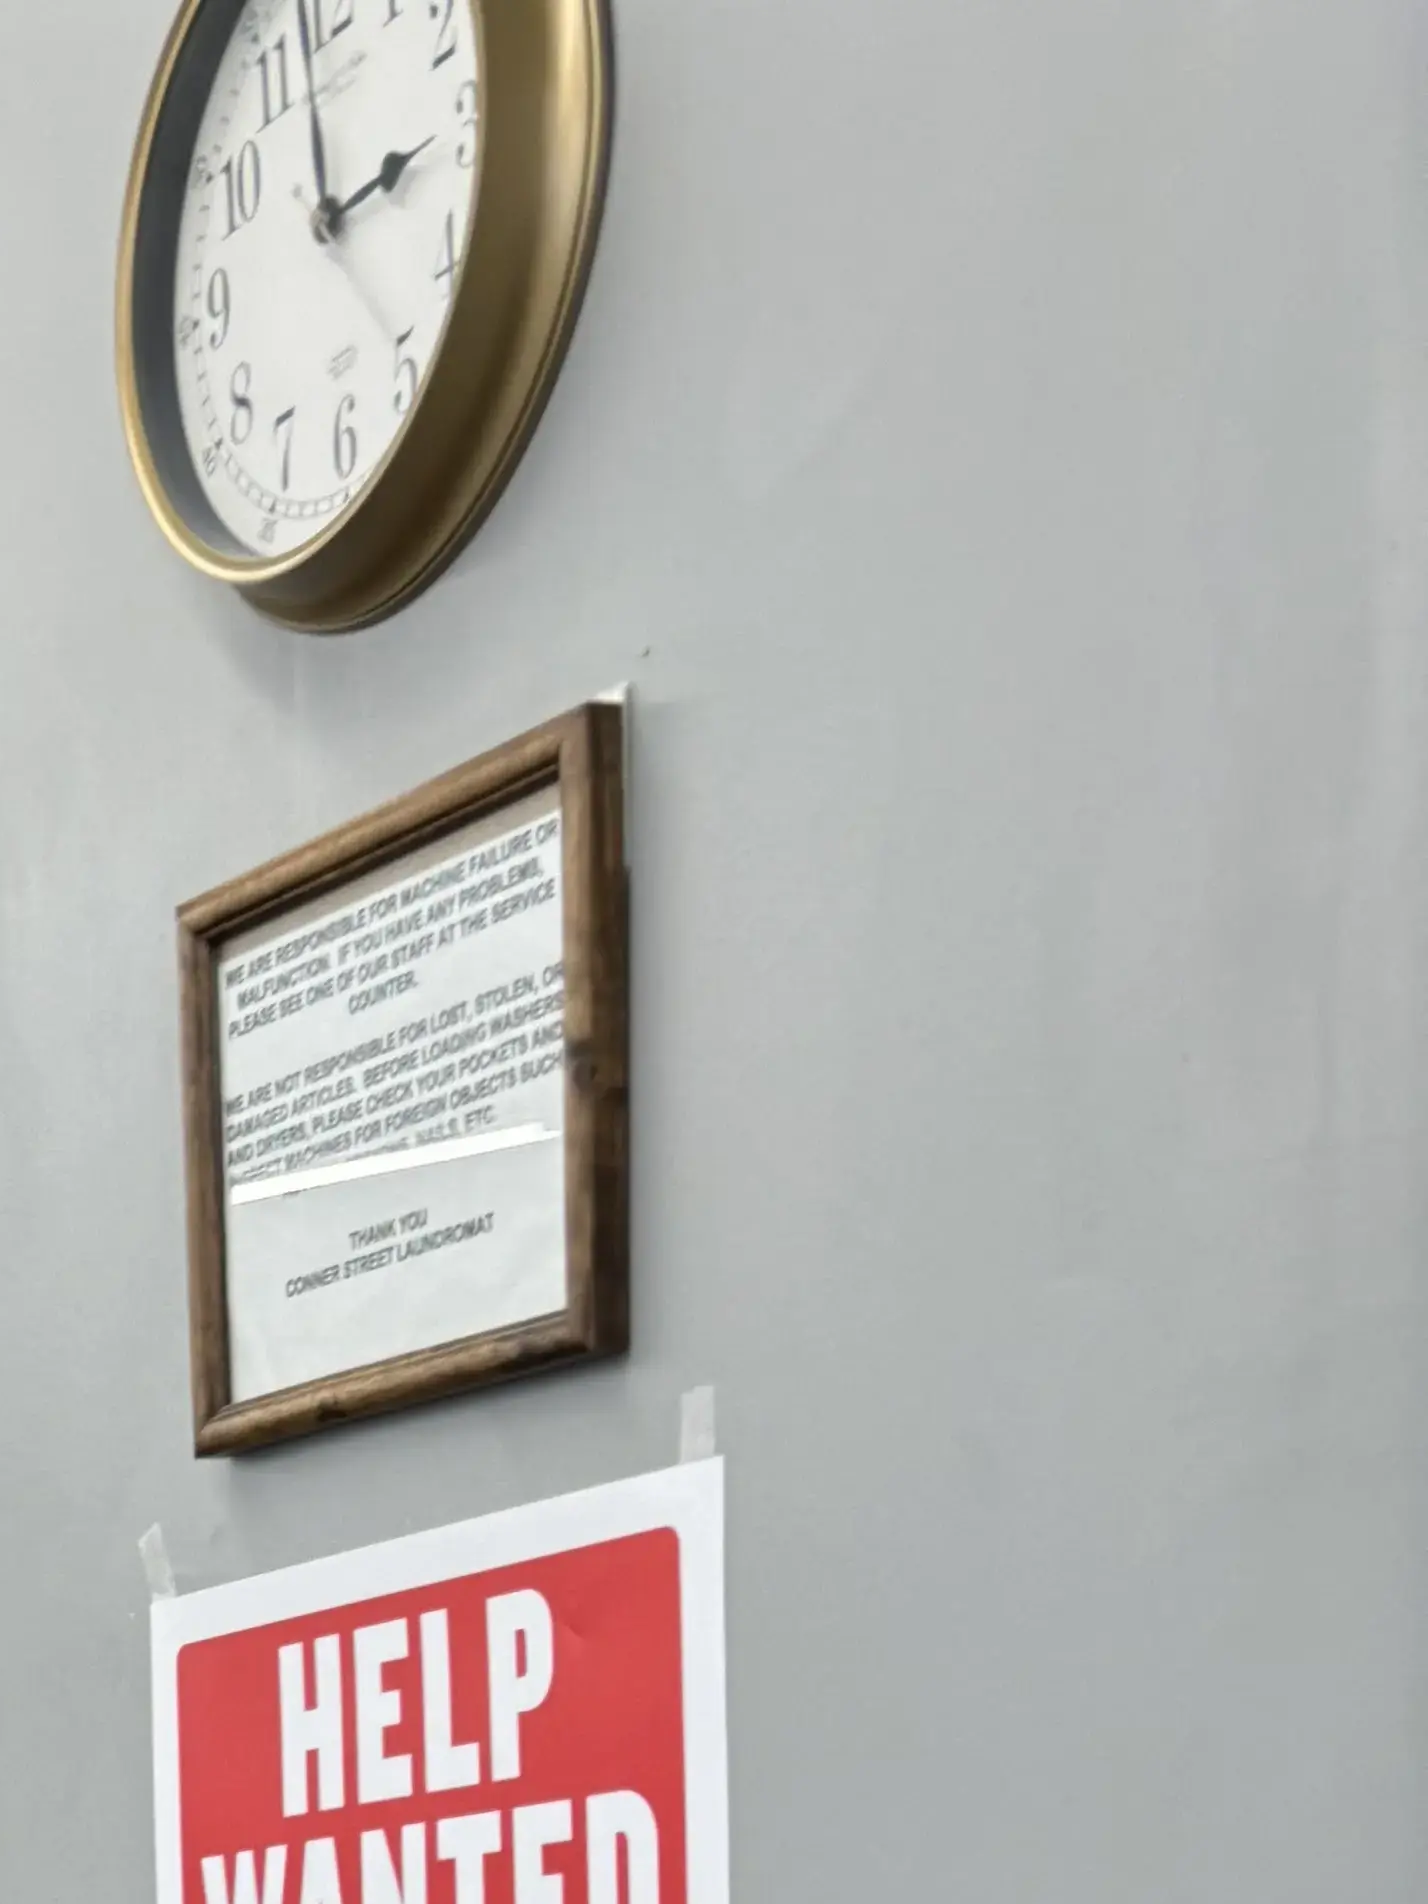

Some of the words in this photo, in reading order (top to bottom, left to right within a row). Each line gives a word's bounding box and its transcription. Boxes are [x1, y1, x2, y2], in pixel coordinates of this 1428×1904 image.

[430, 0, 457, 71] 2
[254, 33, 295, 134] 11
[455, 80, 477, 169] 3
[220, 140, 261, 241] 10
[434, 208, 462, 300] 4
[207, 268, 231, 350] 9
[229, 360, 253, 446] 8
[394, 325, 419, 416] 5
[272, 405, 296, 492] 7
[333, 393, 357, 480] 6
[248, 952, 273, 976] ARE
[275, 909, 365, 963] RESPONSIBLE
[369, 894, 397, 920] FOR
[400, 862, 465, 906] MACHINE
[468, 830, 532, 875] FAILURE
[536, 818, 558, 843] OR
[354, 928, 382, 956] YOU
[385, 910, 423, 942] HAVE
[426, 895, 455, 923] ANY
[228, 1003, 276, 1038] PLEASE
[279, 991, 303, 1017] SEE
[306, 978, 333, 1005] ONE
[336, 968, 355, 991] OF
[357, 954, 388, 982] OUR
[390, 933, 434, 967] STAFF
[436, 923, 457, 947] AT
[459, 909, 487, 937] THE
[491, 879, 555, 923] SERVICE
[226, 1103, 288, 1141] DAMAGED
[363, 1050, 419, 1086] BEFORE
[422, 1022, 487, 1063] LOADING
[248, 1083, 271, 1106] ARE
[274, 1071, 300, 1095] NOT
[304, 1032, 395, 1083] RESPONSIBLE
[399, 1018, 426, 1045] FOR
[312, 1100, 362, 1134] PLEASE
[365, 1080, 413, 1113] CHECK
[415, 1063, 455, 1094] YOUR
[458, 1034, 527, 1077] POCKETS
[354, 1120, 381, 1144] FOR
[449, 1068, 516, 1108] OBJECTS
[343, 1247, 394, 1277] STREET
[395, 1212, 494, 1261] LAUNDROMAT
[347, 1219, 396, 1249] THANK
[398, 1208, 428, 1232] YOU
[278, 1588, 555, 1818] HELP
